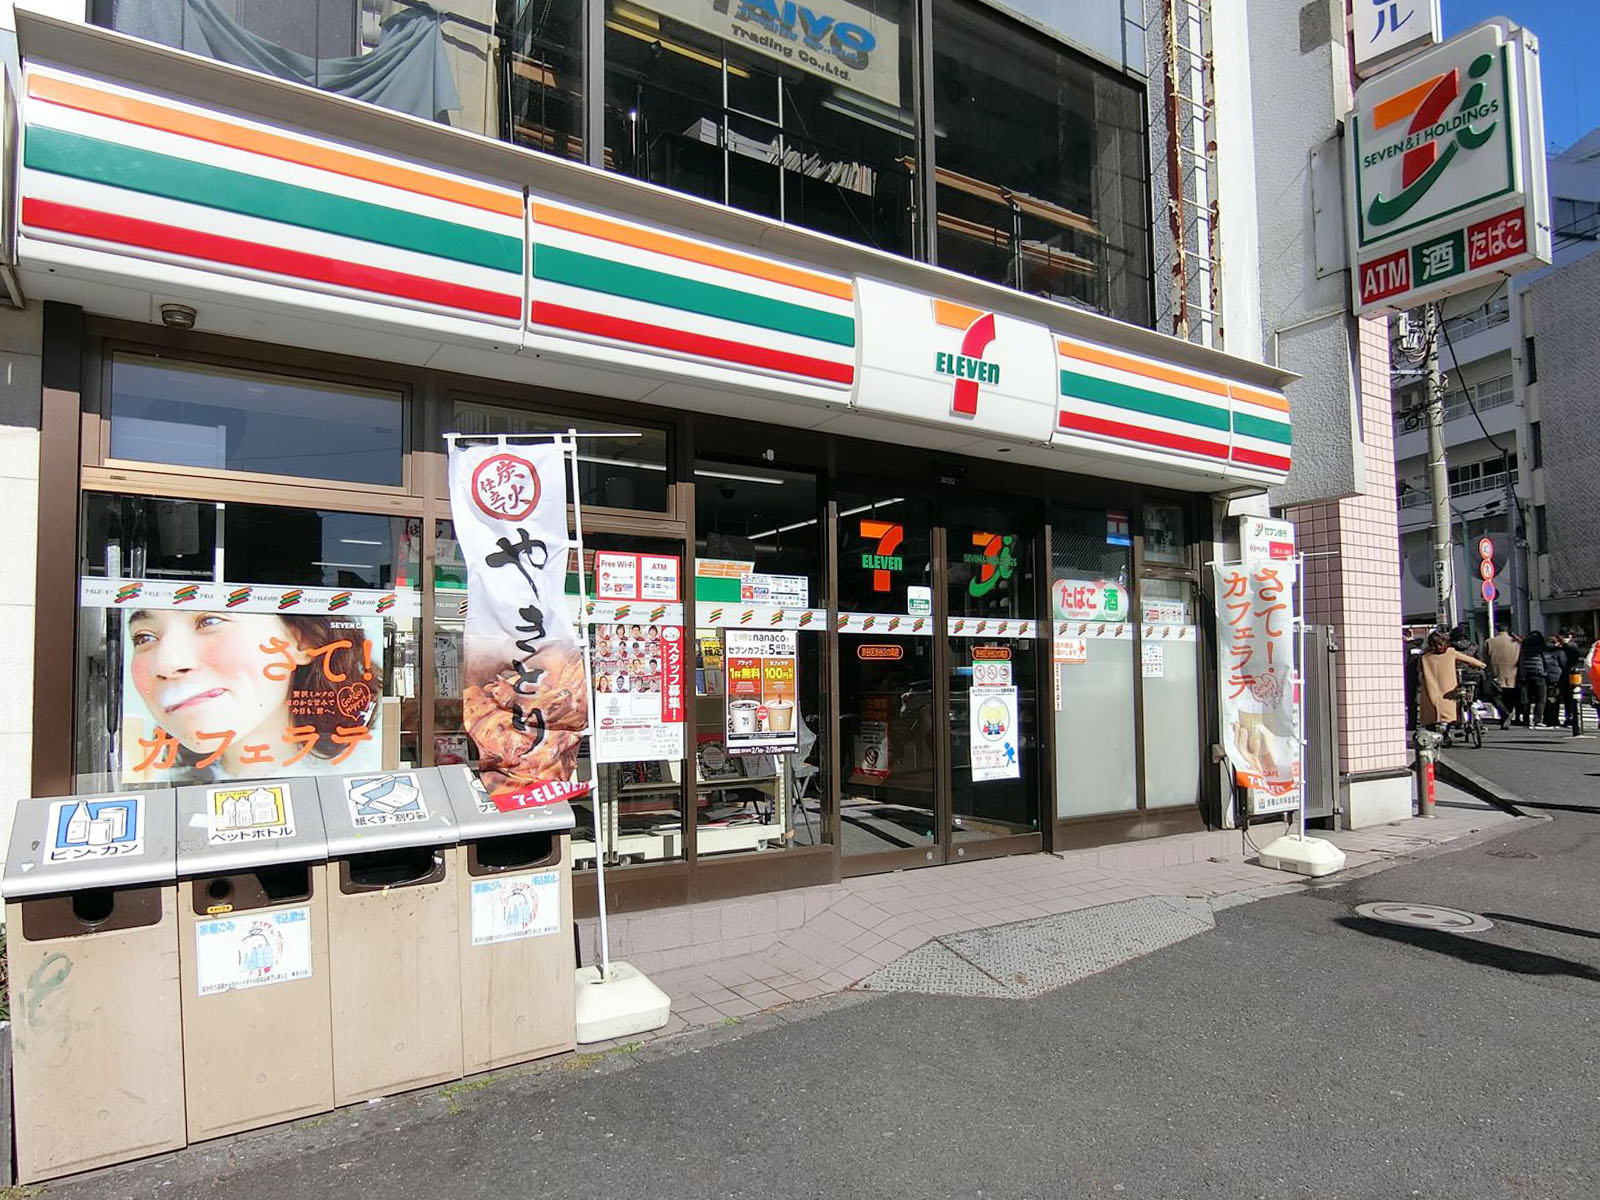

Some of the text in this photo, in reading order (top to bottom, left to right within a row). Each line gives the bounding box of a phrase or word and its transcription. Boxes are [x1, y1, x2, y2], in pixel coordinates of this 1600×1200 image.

[713, 0, 876, 71] AIYO
[731, 24, 793, 58] Trading
[1370, 0, 1415, 43] ル
[1424, 99, 1499, 141] HOLDINGS
[1422, 240, 1455, 280] 酒
[1470, 218, 1524, 262] たばこ
[1363, 257, 1407, 298] ATM
[600, 560, 635, 569] Free Wi-Fi
[651, 563, 667, 571] ATM
[1060, 585, 1097, 610] たばこ
[1103, 588, 1119, 612] 酒
[485, 527, 548, 758] やきとり
[752, 634, 786, 643] nanaco
[1222, 570, 1256, 700] カフェラテ
[132, 724, 373, 772] カフェラテ
